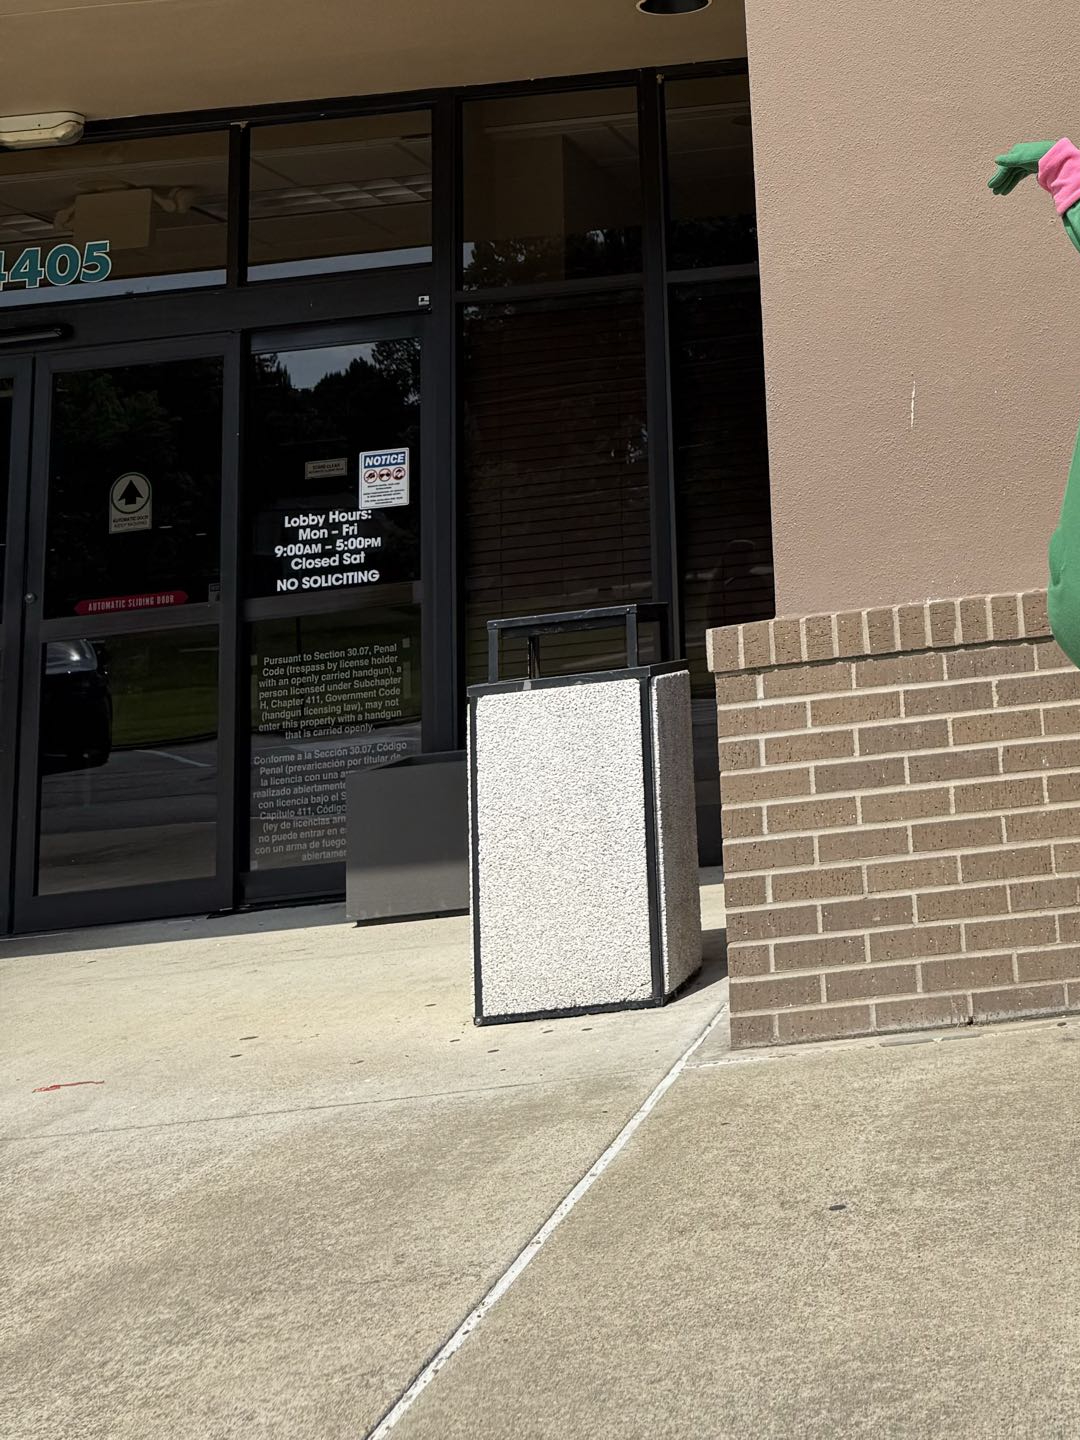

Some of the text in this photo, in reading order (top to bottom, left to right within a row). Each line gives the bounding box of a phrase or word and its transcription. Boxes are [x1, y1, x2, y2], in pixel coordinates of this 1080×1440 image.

[0, 240, 112, 291] 405
[365, 453, 405, 466] NOTICE
[284, 510, 372, 527] Lobby Hours:
[299, 528, 328, 540] Mon
[343, 524, 358, 536] Fri
[275, 544, 321, 557] 9:00AM
[336, 537, 381, 551] 5:00PM
[291, 552, 365, 570] Closed Sat
[277, 570, 380, 591] NO SOLICITING
[89, 595, 174, 611] AUTOMATIC SLIDING DOOR
[264, 654, 301, 666] Pursuant
[303, 653, 312, 662] to
[314, 650, 345, 660] Section
[374, 644, 397, 654] Penal
[263, 656, 398, 677] Code (trespass by license holder
[259, 679, 276, 688] with
[291, 674, 319, 685] openly
[321, 671, 350, 681] carried
[259, 676, 401, 700] person licensed under Subchapter
[260, 702, 269, 710] H,
[271, 699, 304, 709] Chapter
[326, 691, 377, 703] Government
[379, 687, 400, 696] Code
[262, 711, 301, 721] (handgun
[304, 706, 341, 716] licensing
[366, 702, 382, 710] may
[385, 698, 399, 707] not
[259, 724, 280, 732] enter
[283, 720, 298, 729] this
[300, 716, 335, 729] property
[338, 714, 355, 722] with
[365, 709, 401, 720] handgun
[313, 726, 342, 737] carried
[254, 755, 294, 765] Conforme
[314, 748, 347, 758] Sección
[377, 742, 406, 751] Código
[260, 767, 283, 775] Penal
[347, 759, 361, 768] por
[364, 755, 388, 764] titular
[261, 778, 268, 787] la
[271, 775, 302, 785] licencia
[305, 773, 320, 781] con
[253, 788, 291, 798] realizado
[258, 801, 274, 809] con
[277, 797, 308, 807] licencia
[311, 795, 328, 805] bajo
[331, 792, 339, 801] el
[263, 823, 277, 833] (ley
[280, 822, 290, 830] de
[293, 818, 330, 828] licencias
[259, 835, 269, 843] no
[272, 832, 297, 843] puede
[300, 830, 325, 839] entrar
[327, 828, 338, 836] en
[273, 845, 284, 853] un
[286, 842, 307, 851] arma
[310, 840, 320, 848] de
[323, 838, 346, 849] fuego
